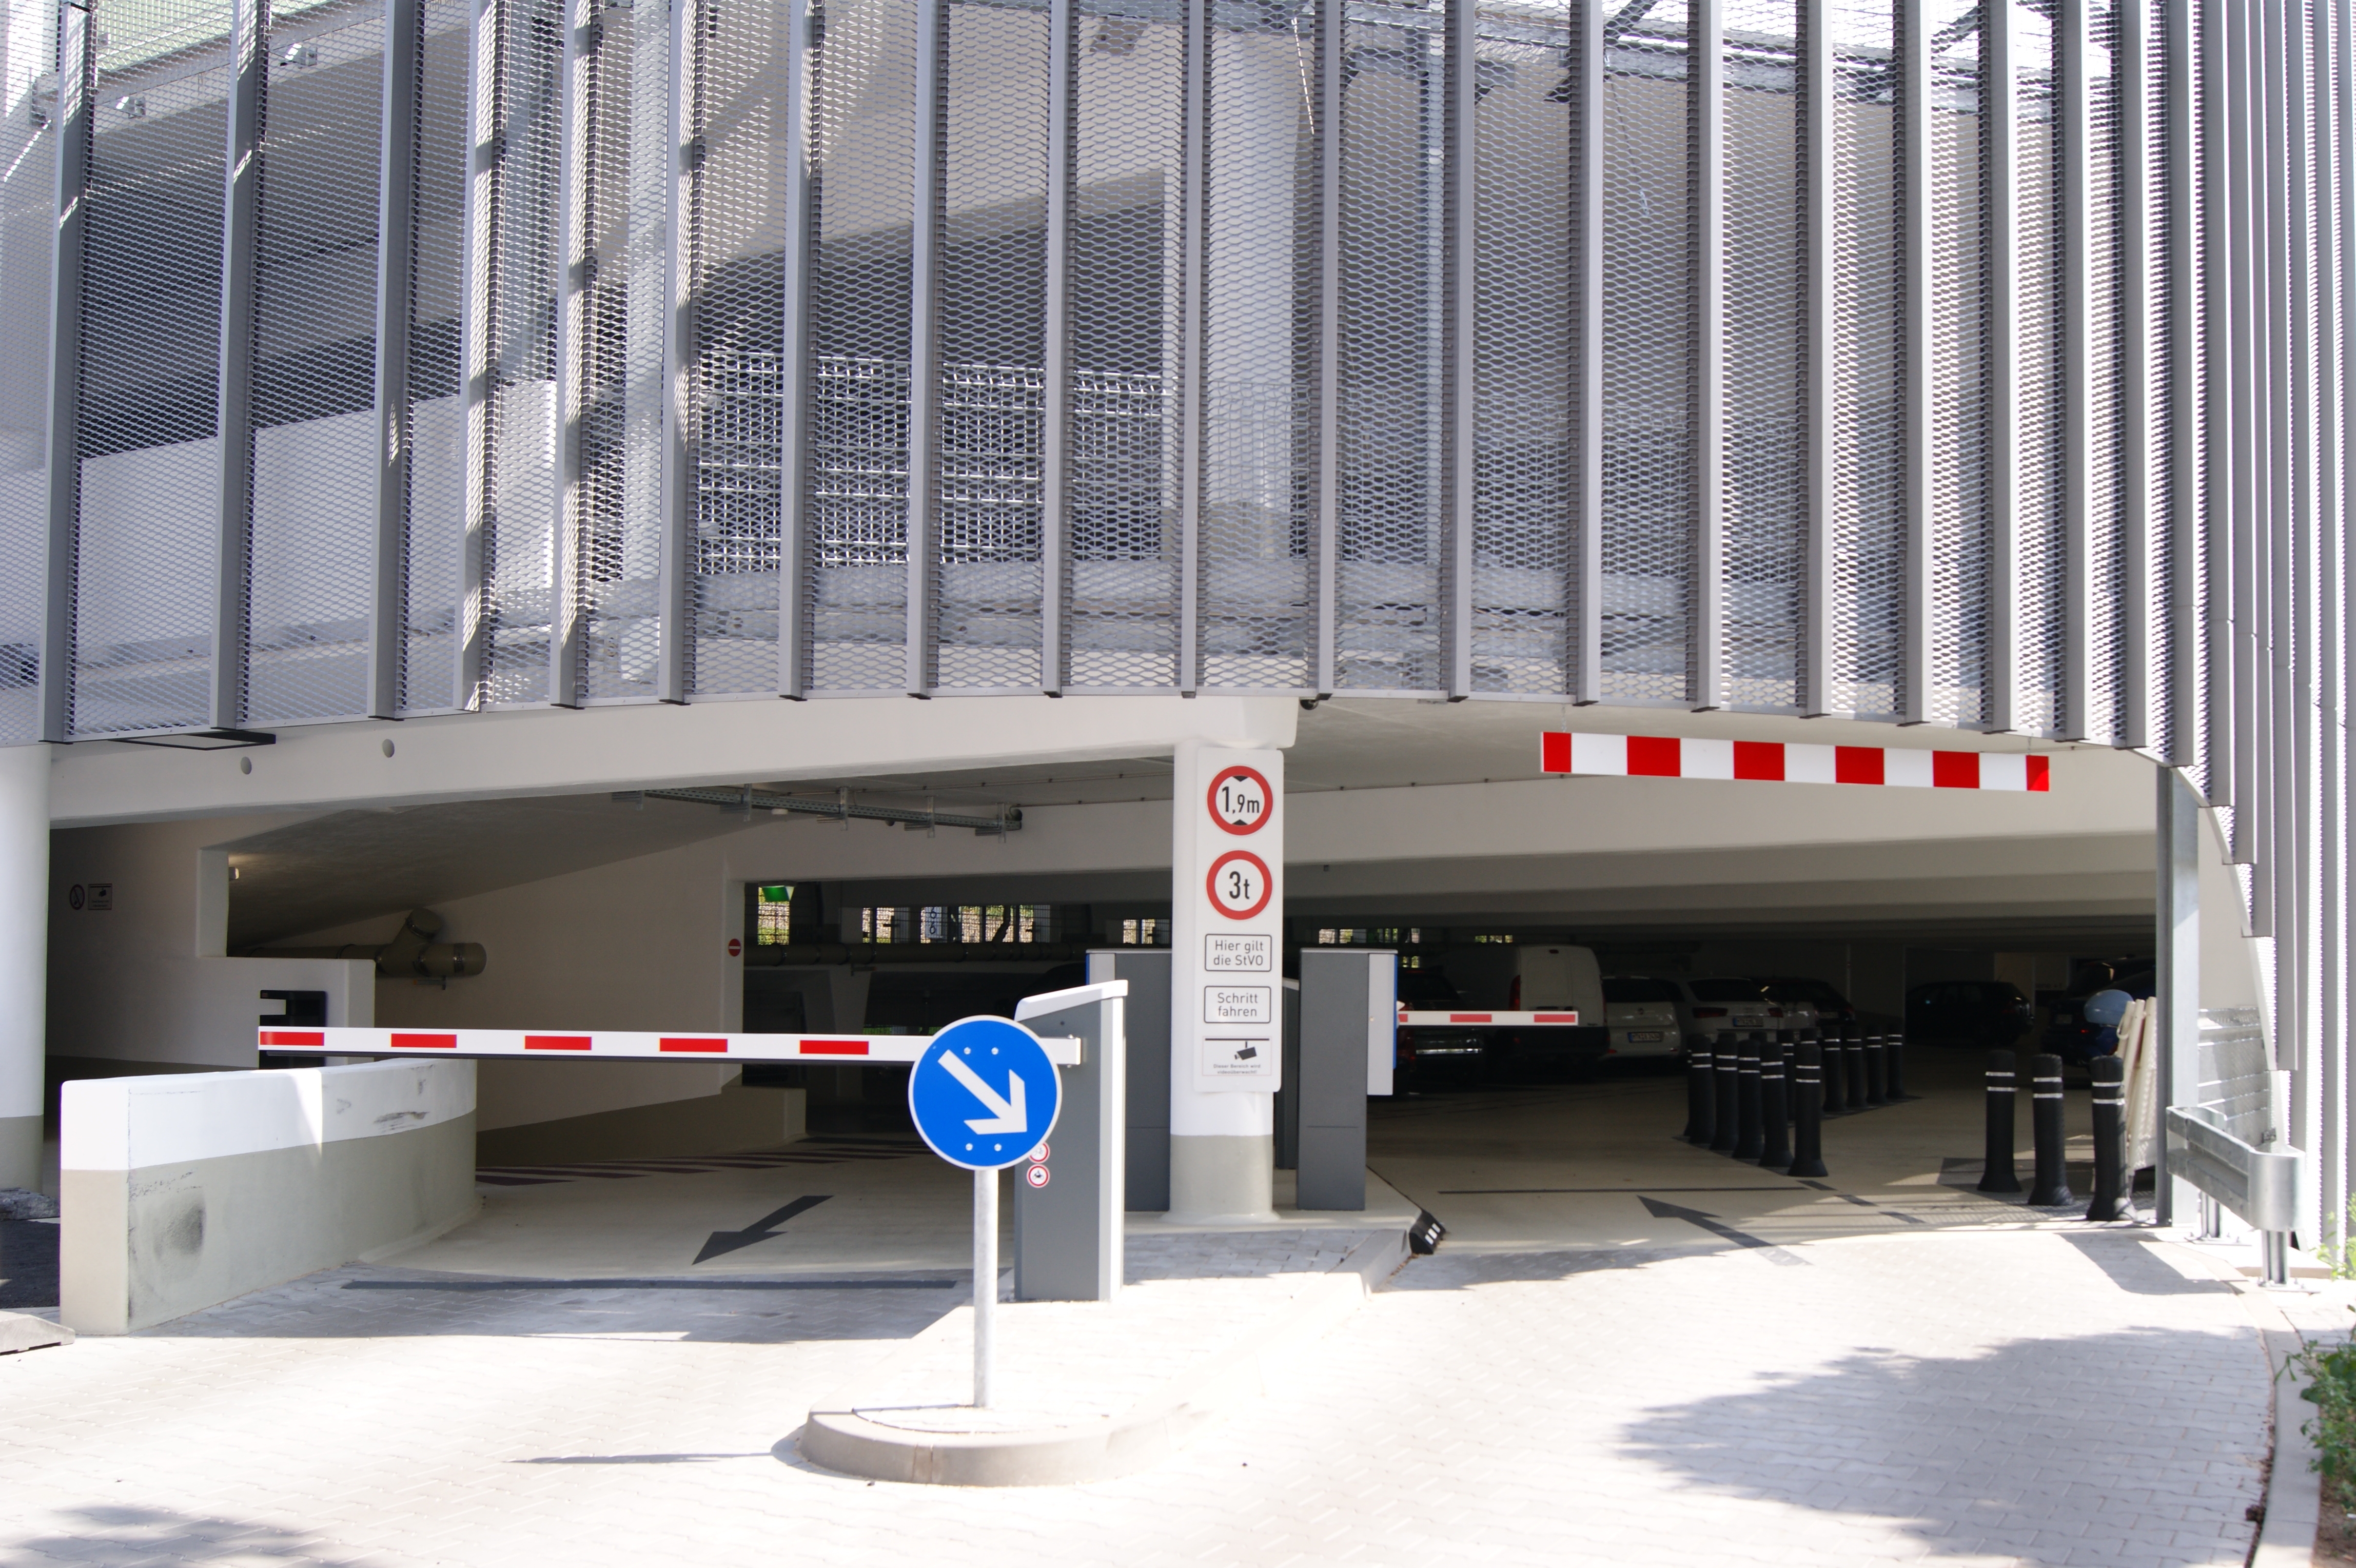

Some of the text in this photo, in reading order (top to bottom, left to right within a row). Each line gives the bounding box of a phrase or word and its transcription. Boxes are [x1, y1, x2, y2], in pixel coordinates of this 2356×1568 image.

[1222, 786, 1260, 814] 1,9m
[1215, 939, 1264, 954] Hier gilt
[1213, 954, 1264, 966] die StVO
[1218, 992, 1258, 1004] Schritt
[1218, 1005, 1257, 1017] fahren
